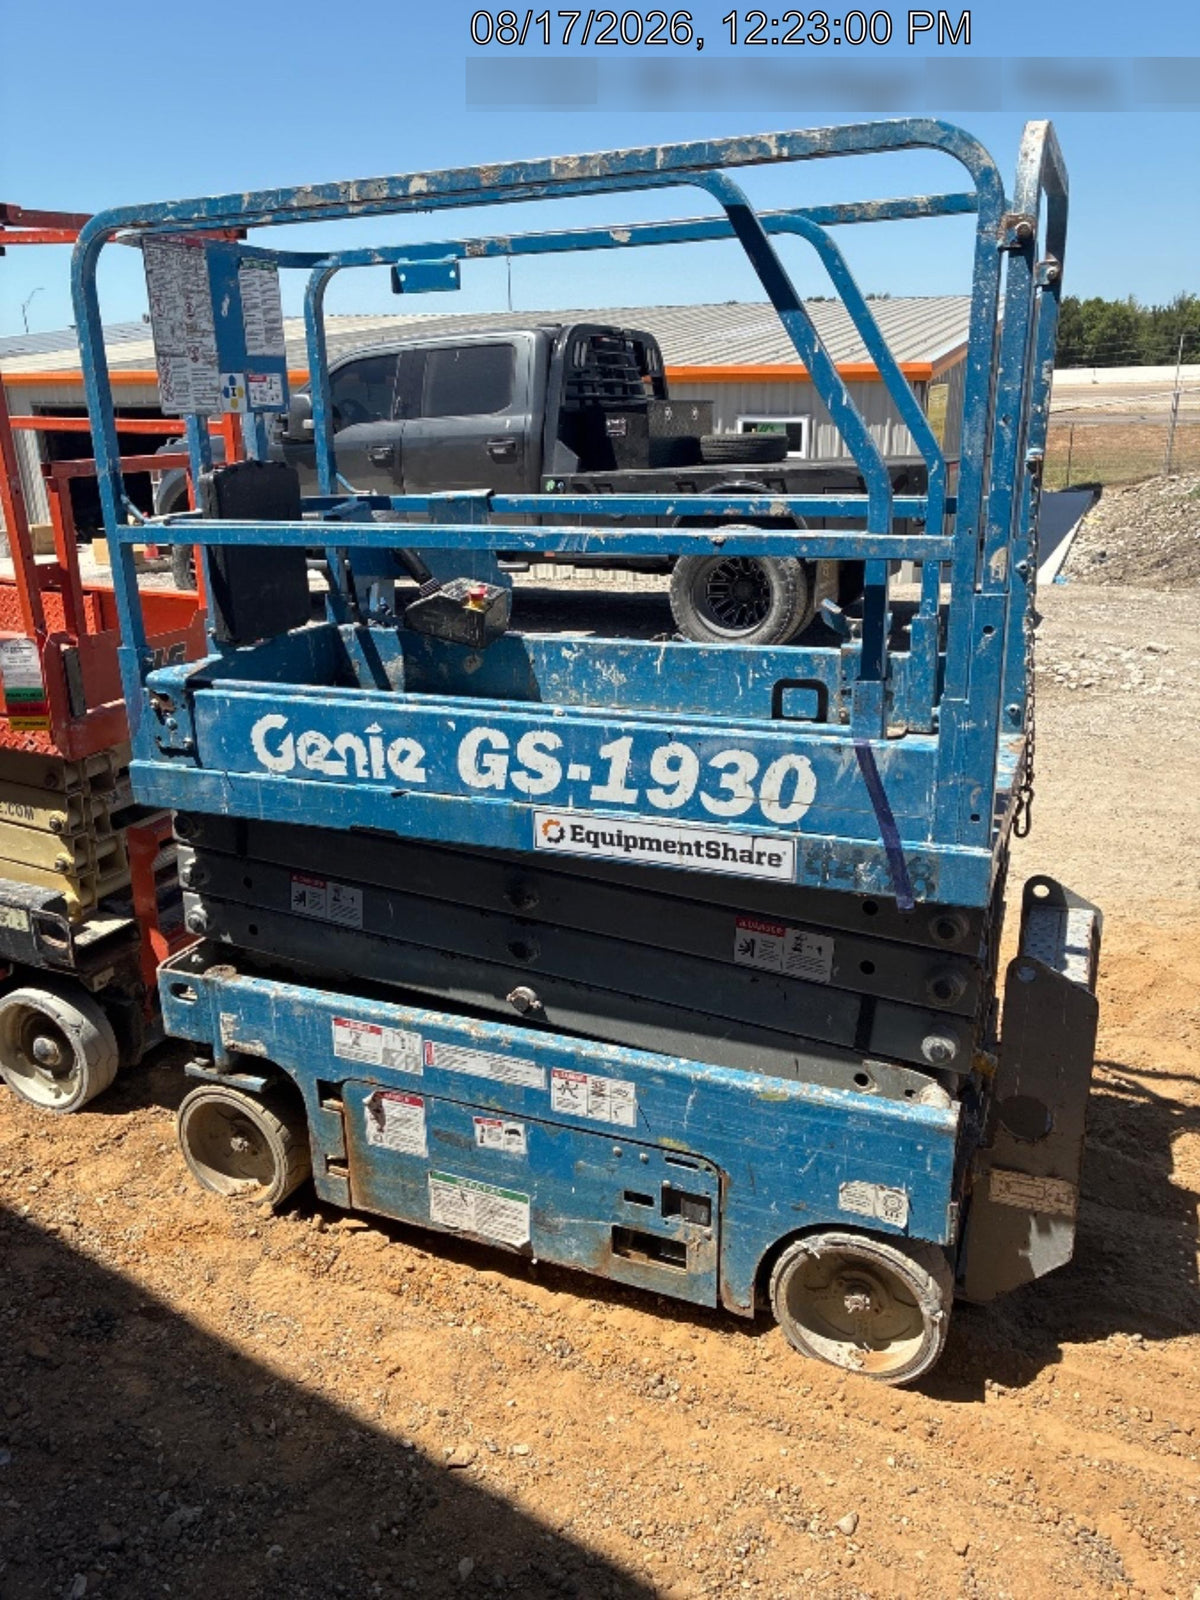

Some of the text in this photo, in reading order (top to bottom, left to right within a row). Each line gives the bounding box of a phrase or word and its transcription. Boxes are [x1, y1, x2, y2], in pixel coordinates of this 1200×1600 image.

[251, 713, 817, 824] Genie GS-1930
[569, 823, 786, 869] EquipmentShare
